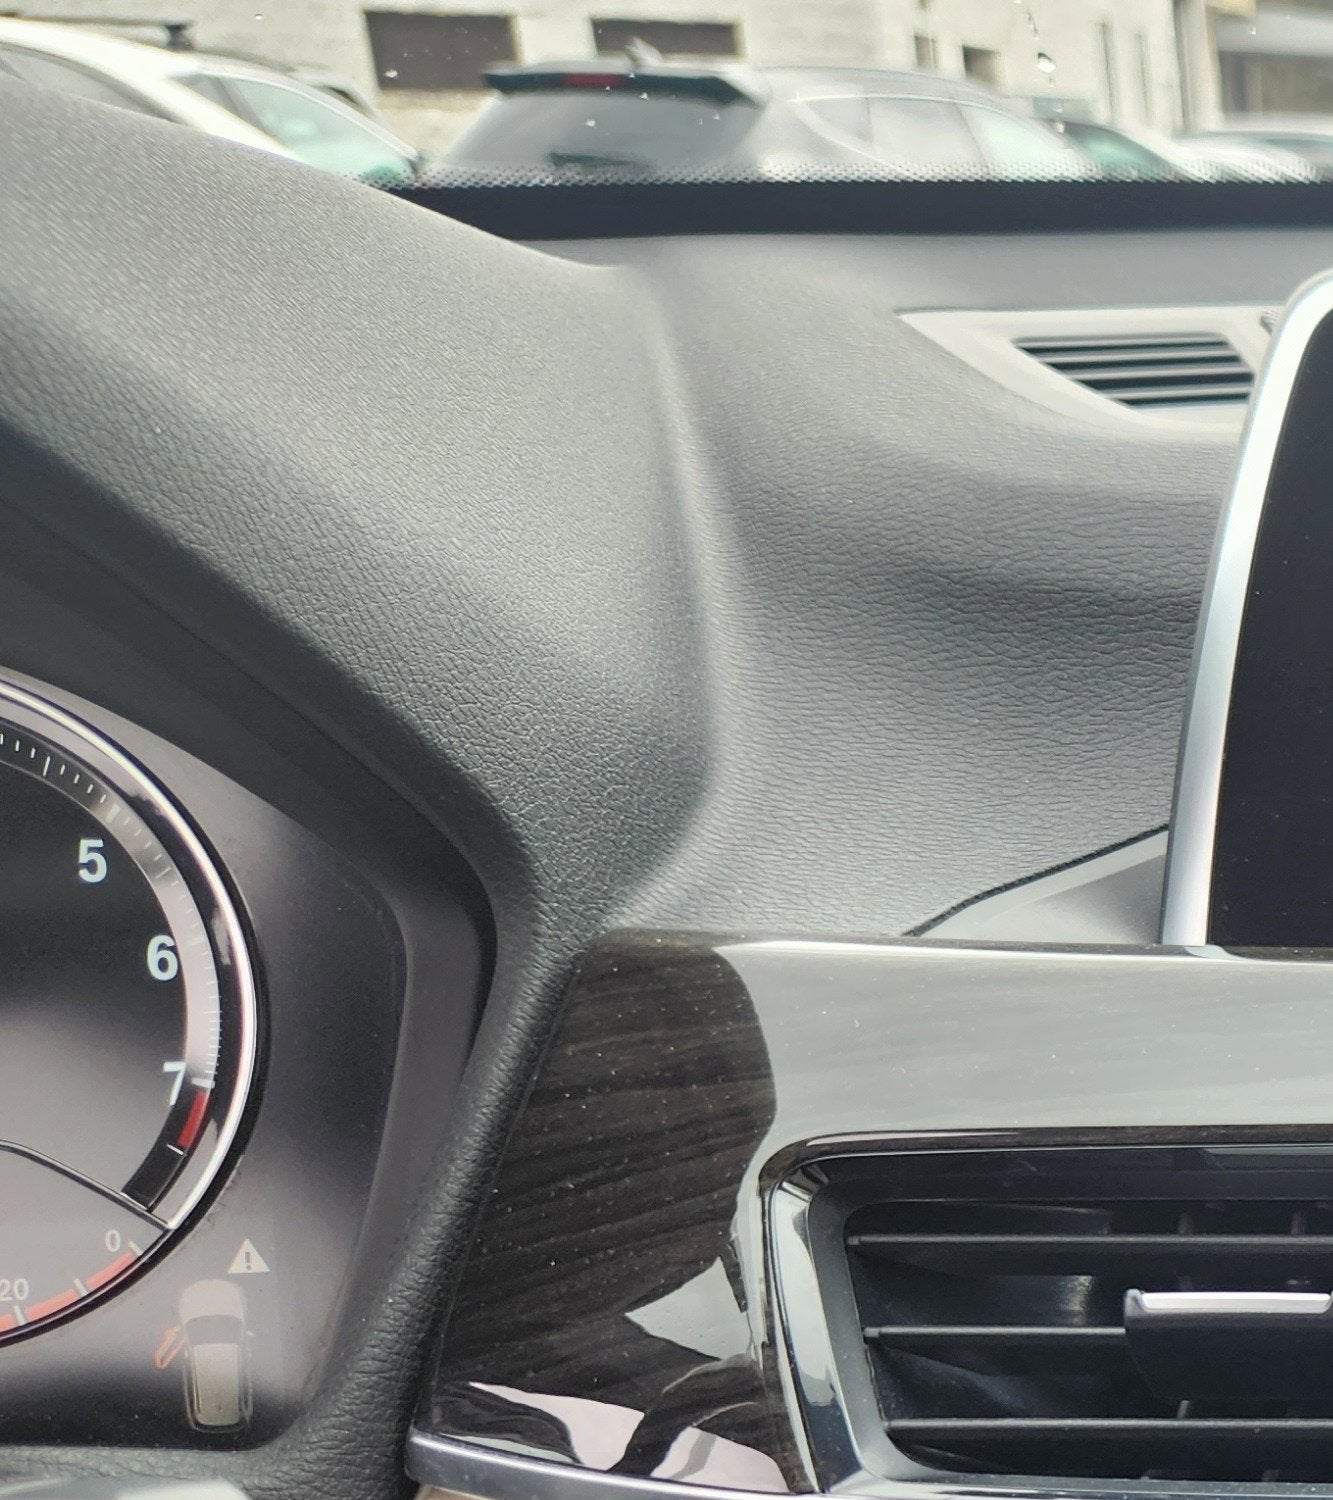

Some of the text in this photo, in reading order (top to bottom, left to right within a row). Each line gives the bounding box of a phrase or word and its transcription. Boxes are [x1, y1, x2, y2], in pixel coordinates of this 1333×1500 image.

[77, 838, 107, 883] 5
[146, 936, 179, 981] 6
[161, 1061, 188, 1106] 7
[105, 1229, 121, 1252] 0
